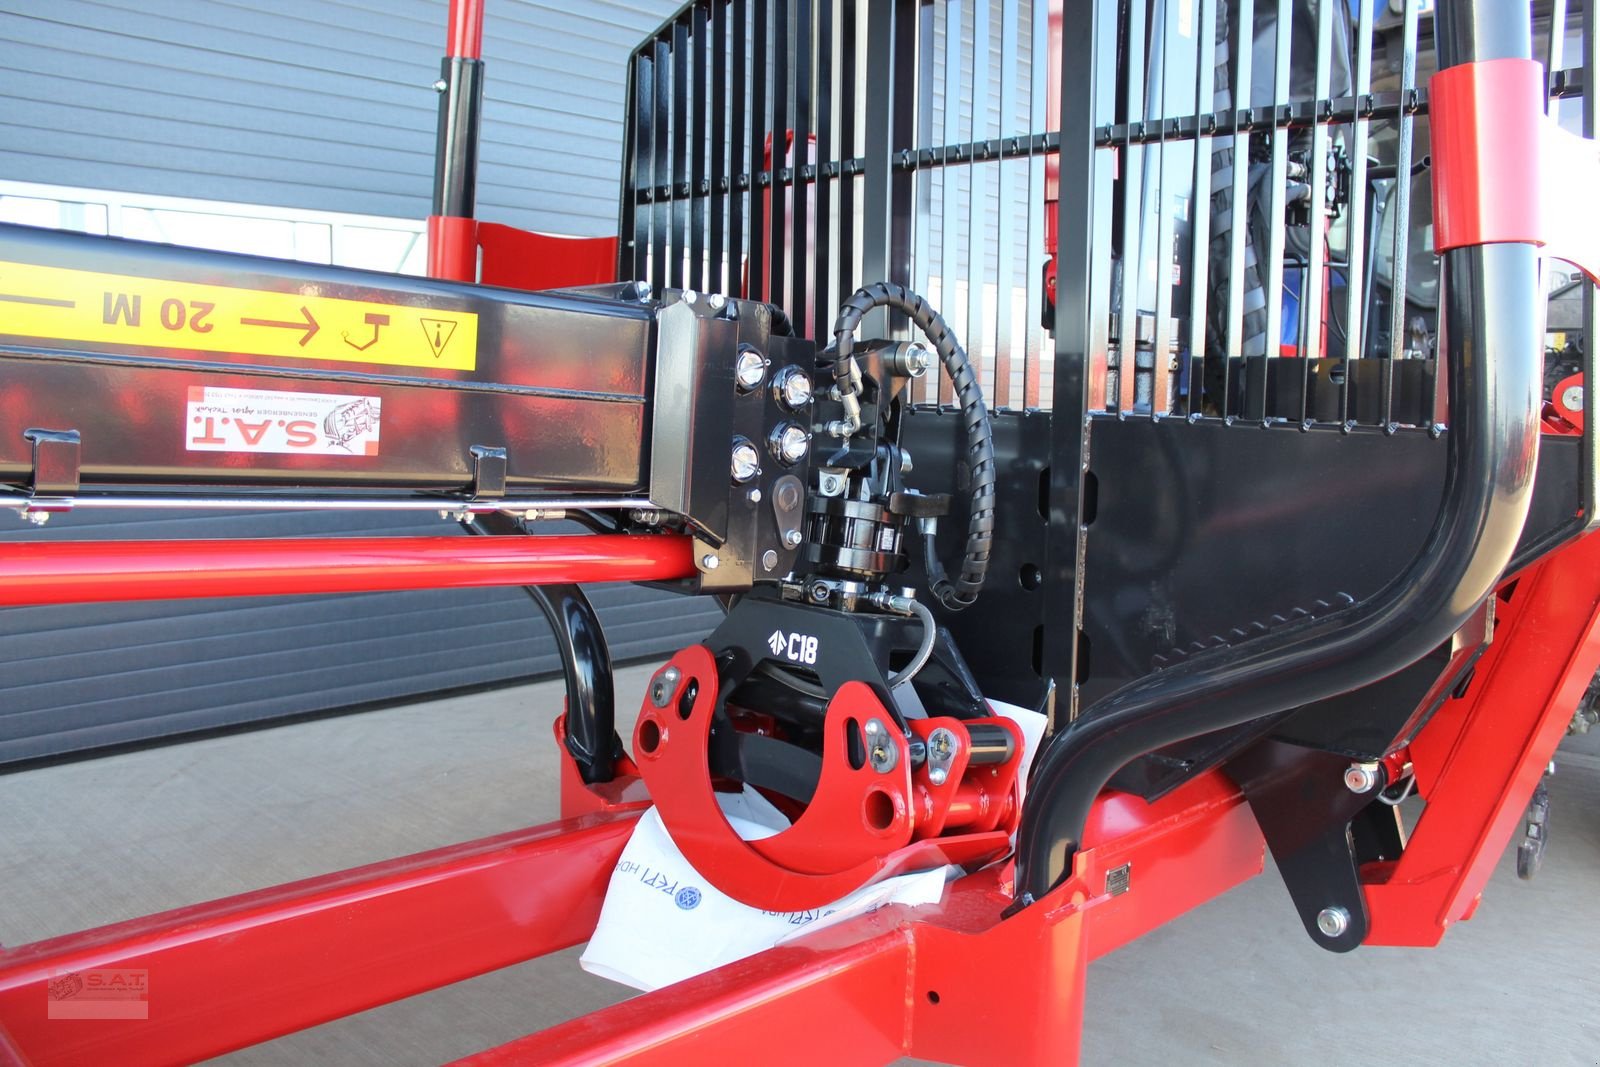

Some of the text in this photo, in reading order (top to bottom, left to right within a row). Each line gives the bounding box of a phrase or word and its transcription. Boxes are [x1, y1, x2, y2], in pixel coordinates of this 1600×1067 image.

[103, 292, 215, 333] 20 M
[192, 416, 317, 447] S.A.T.
[787, 632, 819, 664] C18
